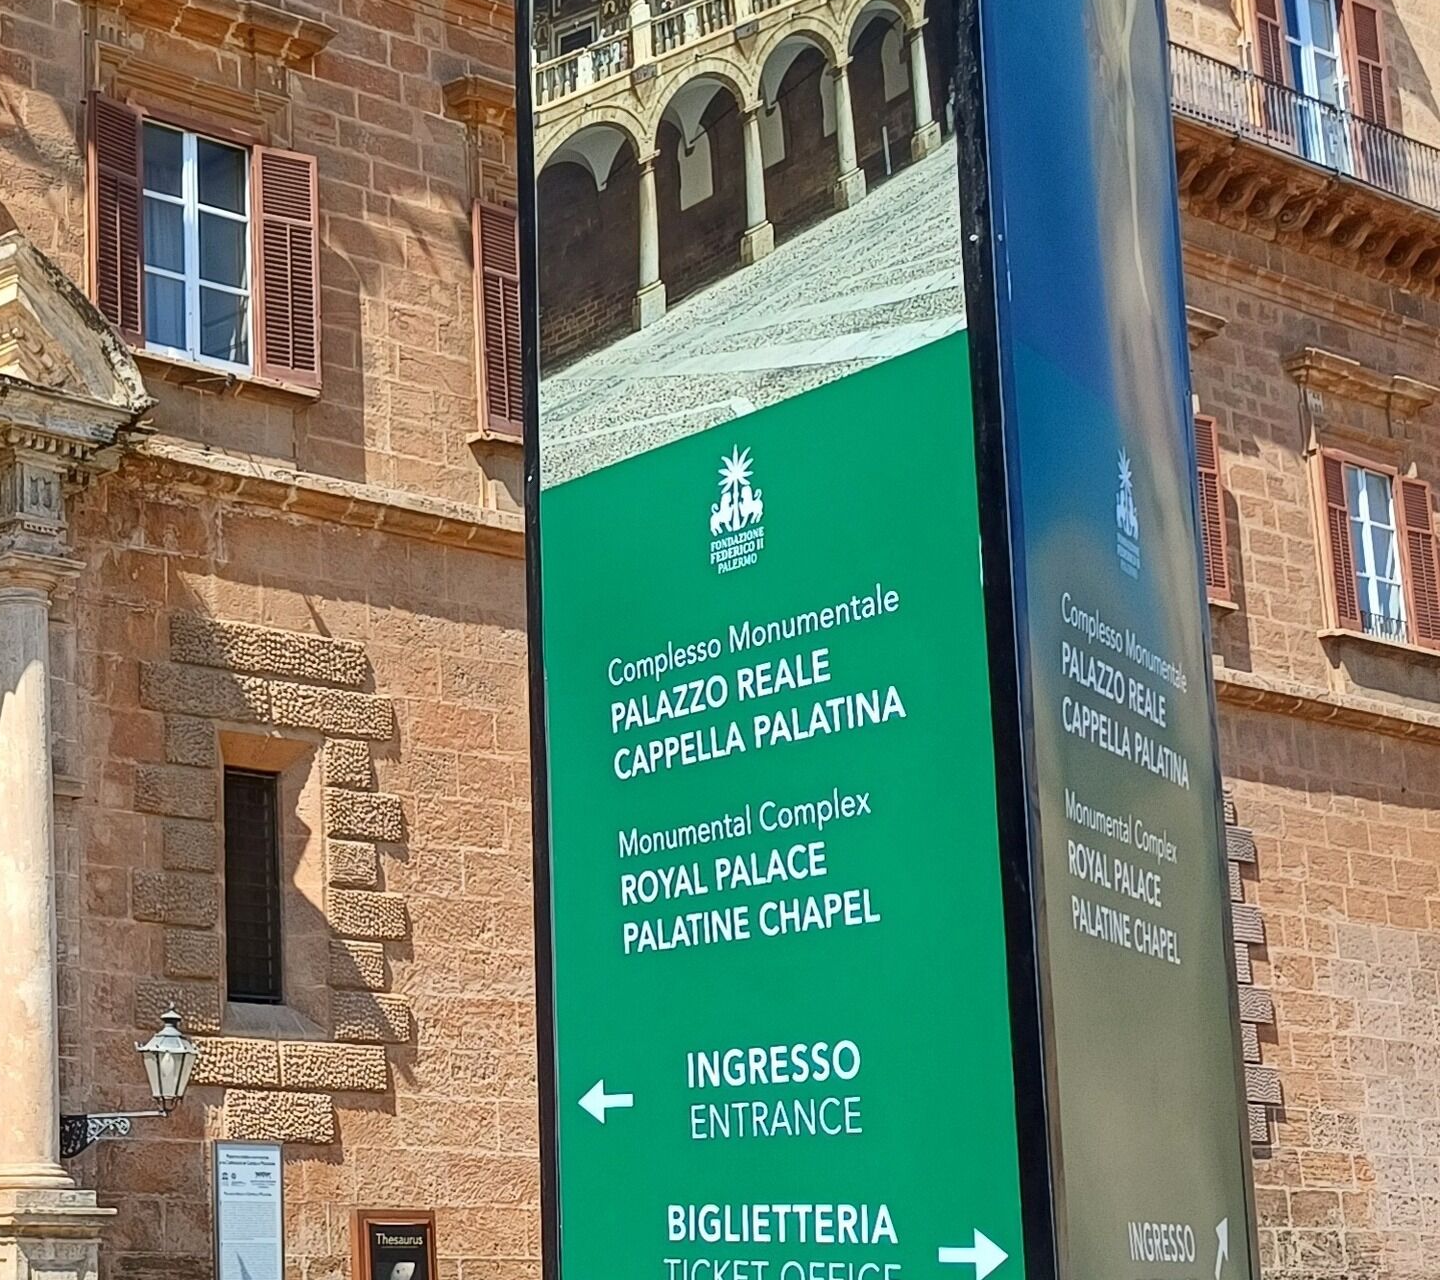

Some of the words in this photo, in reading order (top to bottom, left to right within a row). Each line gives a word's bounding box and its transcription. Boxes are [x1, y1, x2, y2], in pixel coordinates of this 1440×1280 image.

[710, 526, 764, 552] FONDAZIONE
[710, 540, 755, 564] FEDERICO
[718, 553, 758, 574] PALERMO
[609, 639, 721, 685] Complesso
[729, 583, 899, 652] Monumentale
[1062, 593, 1122, 652] Complesso
[1126, 629, 1187, 693] Monumentale
[612, 676, 727, 733] PALAZZO
[738, 648, 830, 700] REALE
[1063, 642, 1124, 704] PALAZZO
[1129, 678, 1166, 727] REALE
[615, 722, 746, 779] CAPPELLA
[754, 686, 906, 748] PALATINA
[1063, 697, 1131, 760] CAPPELLA
[1135, 732, 1189, 790] PALATINA
[619, 804, 751, 857] Monumental
[760, 788, 871, 831] Complex
[1066, 788, 1131, 844] Monumental
[1135, 820, 1176, 863] Complex
[622, 863, 708, 905] ROYAL
[716, 842, 826, 890] PALACE
[1069, 840, 1111, 888] ROYAL
[1115, 860, 1161, 907] PALACE
[624, 907, 750, 954] PALATINE
[760, 889, 880, 936] CHAPEL
[1072, 896, 1131, 948] PALATINE
[1134, 919, 1180, 964] CHAPEL
[688, 1040, 860, 1087] INGRESSO
[691, 1097, 862, 1138] ENTRANCE
[375, 1232, 424, 1246] Thesaurus
[668, 1205, 898, 1243] BIGLIETTERIA
[1128, 1222, 1195, 1262] INGRESSO
